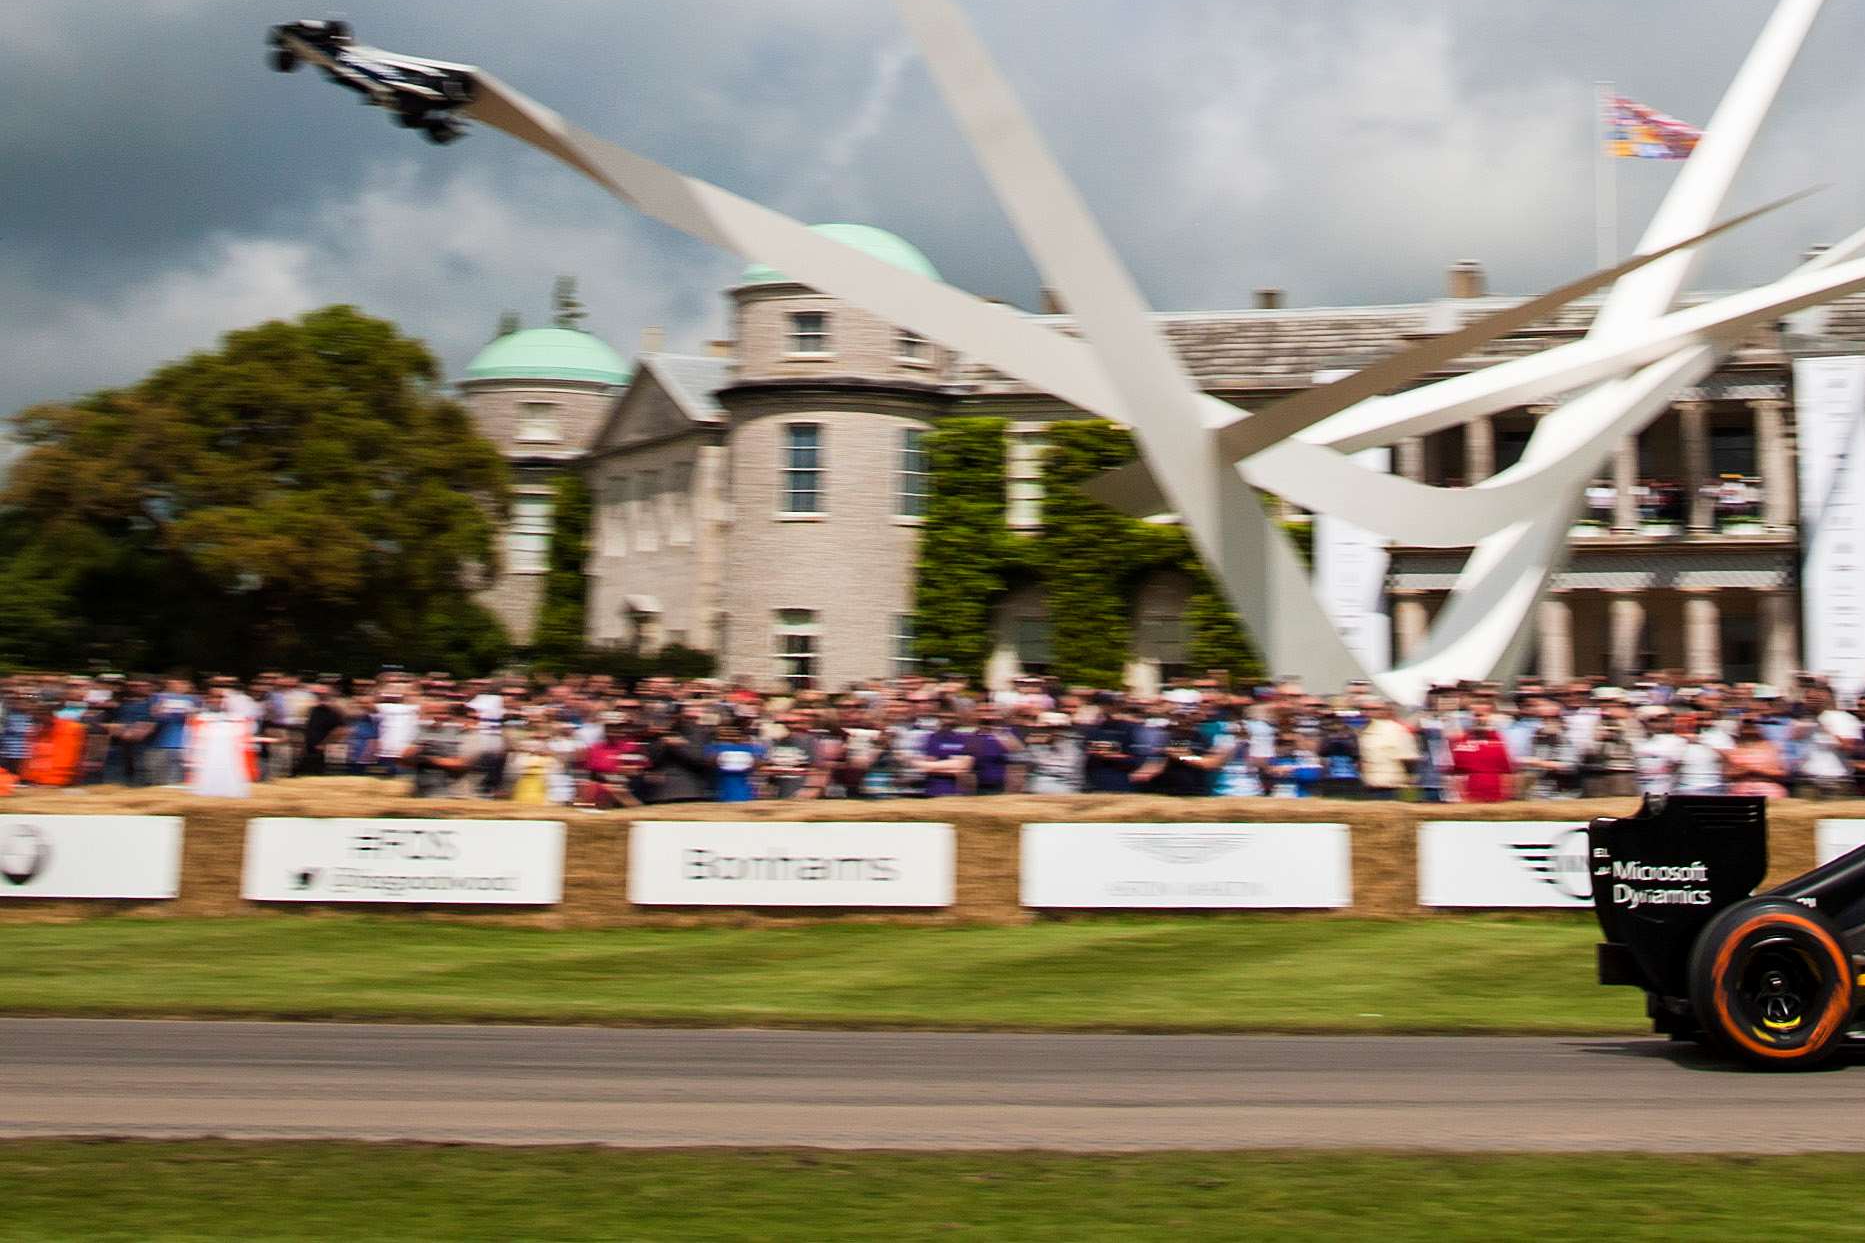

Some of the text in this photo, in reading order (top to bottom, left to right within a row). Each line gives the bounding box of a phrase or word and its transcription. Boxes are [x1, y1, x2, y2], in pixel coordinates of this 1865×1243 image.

[680, 847, 902, 881] Bonhams
[1612, 860, 1709, 881] Microsoft
[1612, 883, 1712, 909] Dynamics
